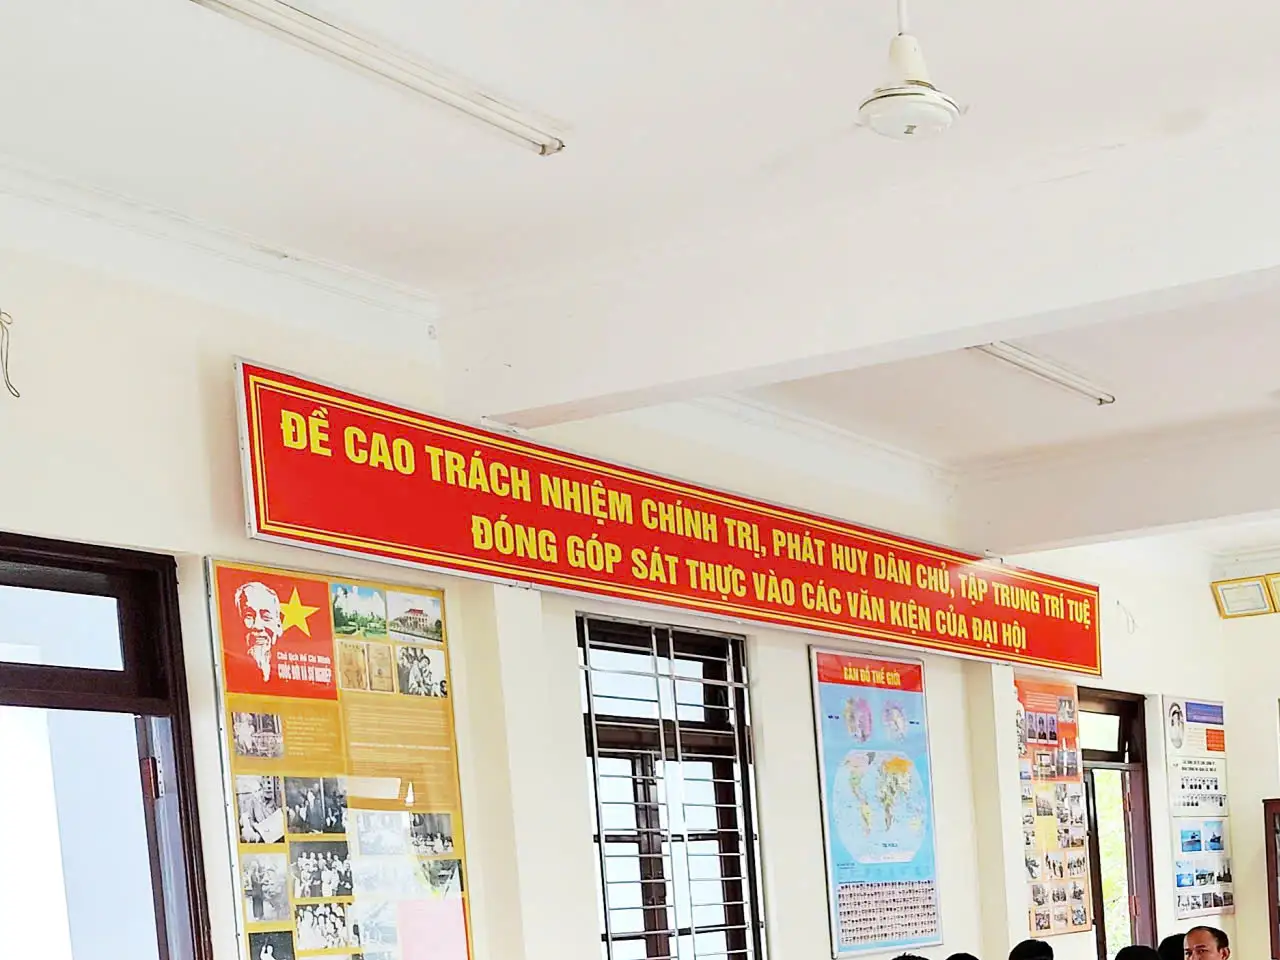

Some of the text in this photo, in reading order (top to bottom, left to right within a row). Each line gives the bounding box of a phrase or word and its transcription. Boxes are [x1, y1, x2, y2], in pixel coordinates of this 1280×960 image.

[280, 407, 1092, 627] ĐỀ CAO TRÁCH NHIỆM CHÍNH TRỊ, PHÁT HUY DÂN CHỦ, TẬP TRUNG TRÍ TUỆ
[471, 514, 1027, 654] ĐÓNG GÓP SÁT THỰC VÀO CÁC VĂN KIỆN CỦA ĐẠI HỘI
[843, 662, 901, 686] BẢN ĐỒ THẾ GIỚI
